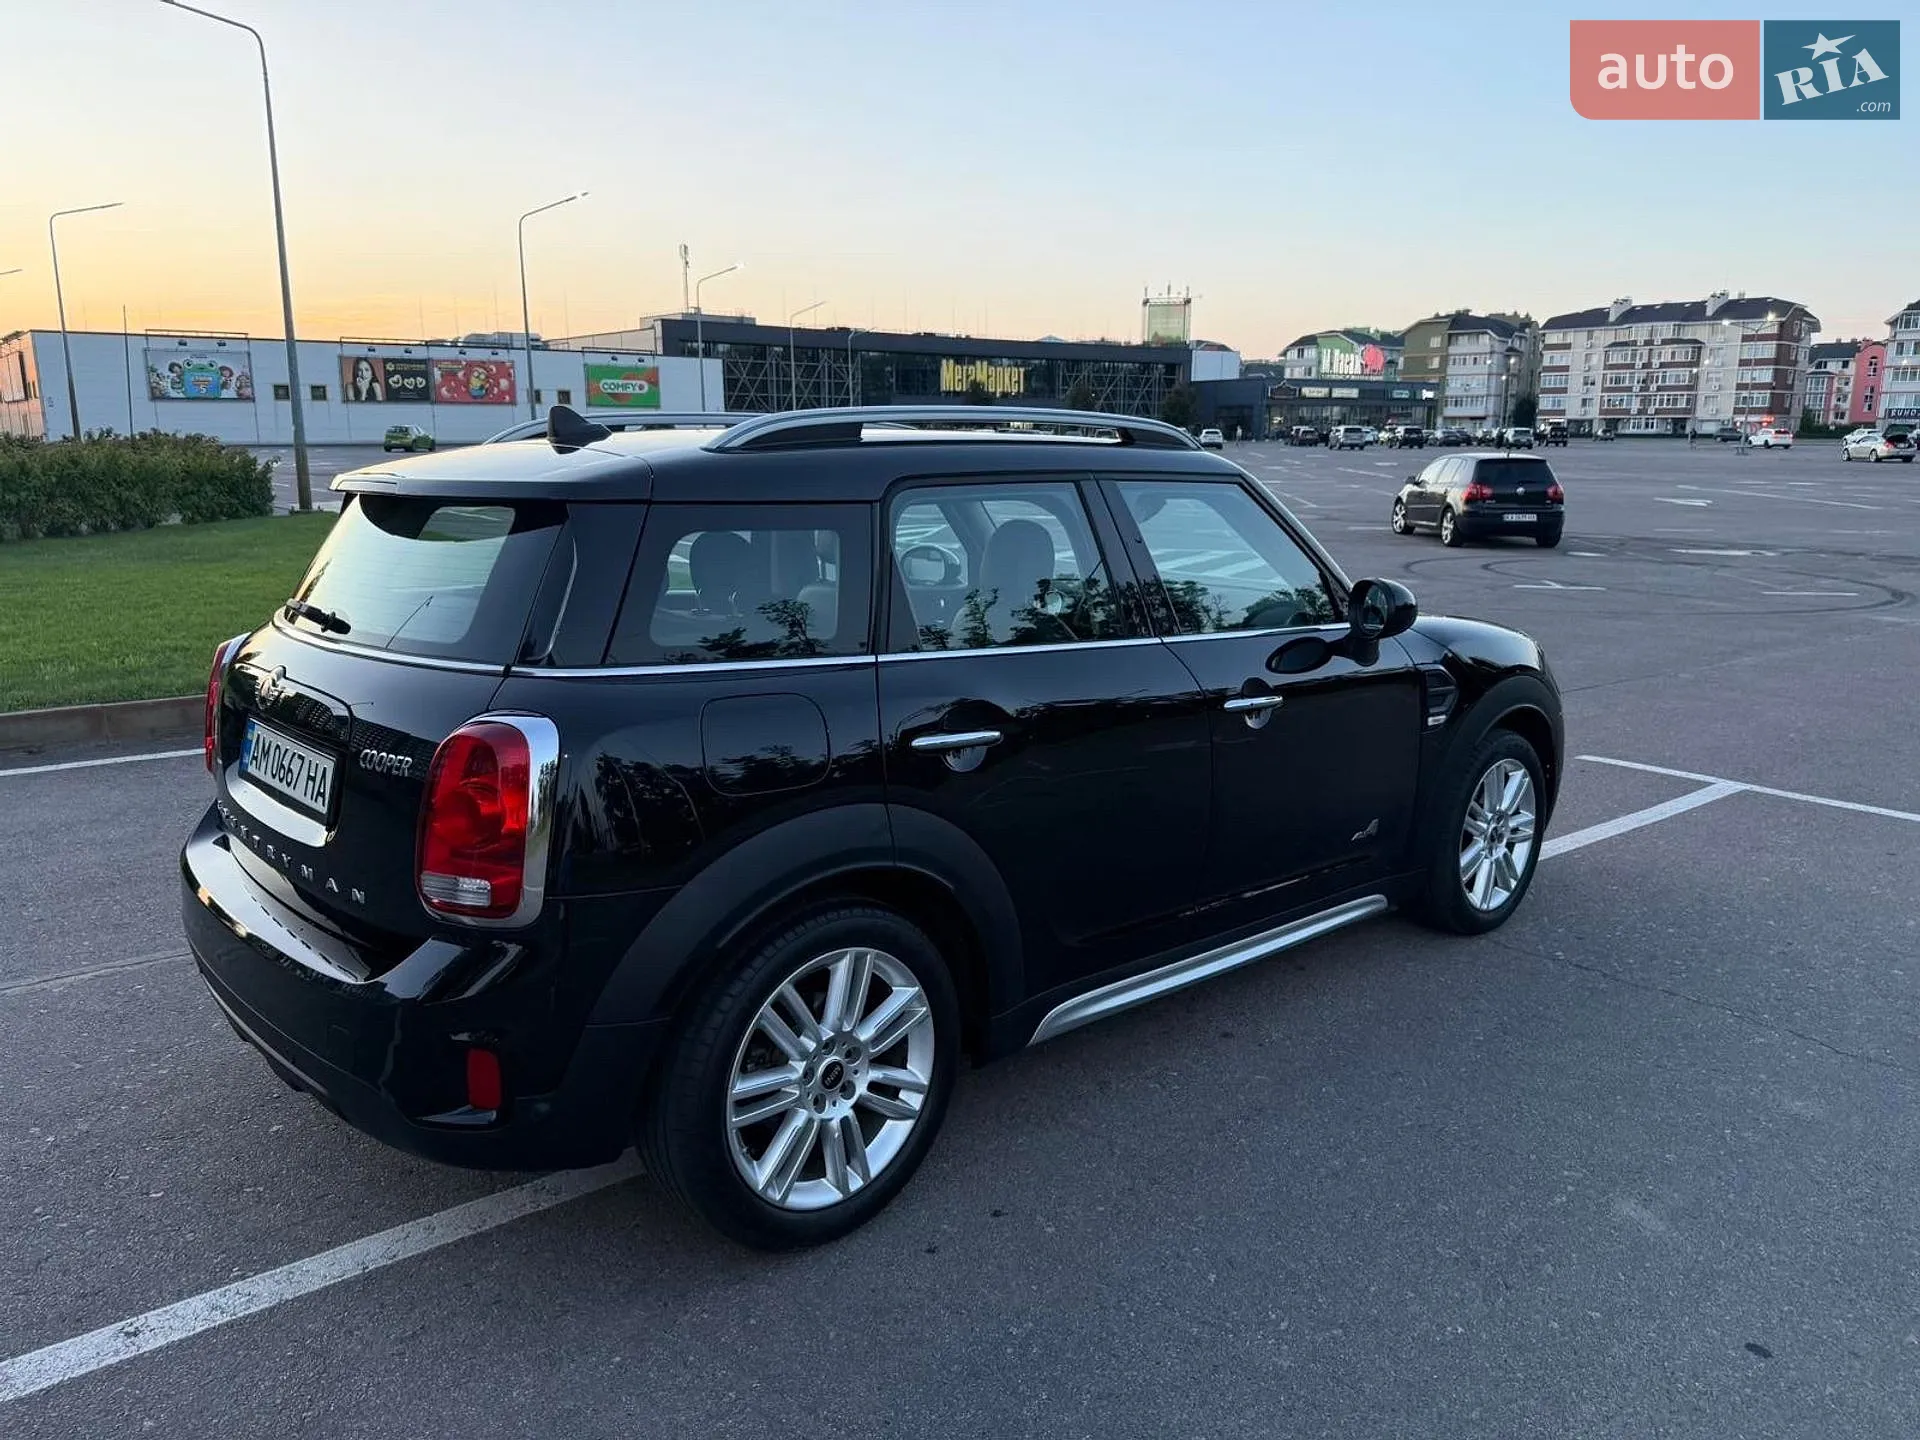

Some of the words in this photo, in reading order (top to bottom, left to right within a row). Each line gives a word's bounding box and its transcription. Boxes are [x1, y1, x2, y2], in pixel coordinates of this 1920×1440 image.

[602, 382, 637, 392] COMFY
[941, 358, 1025, 398] МегаМаркет
[249, 732, 273, 775] AM
[271, 743, 306, 790] 0667
[303, 759, 327, 807] HA
[359, 749, 413, 777] COOPER
